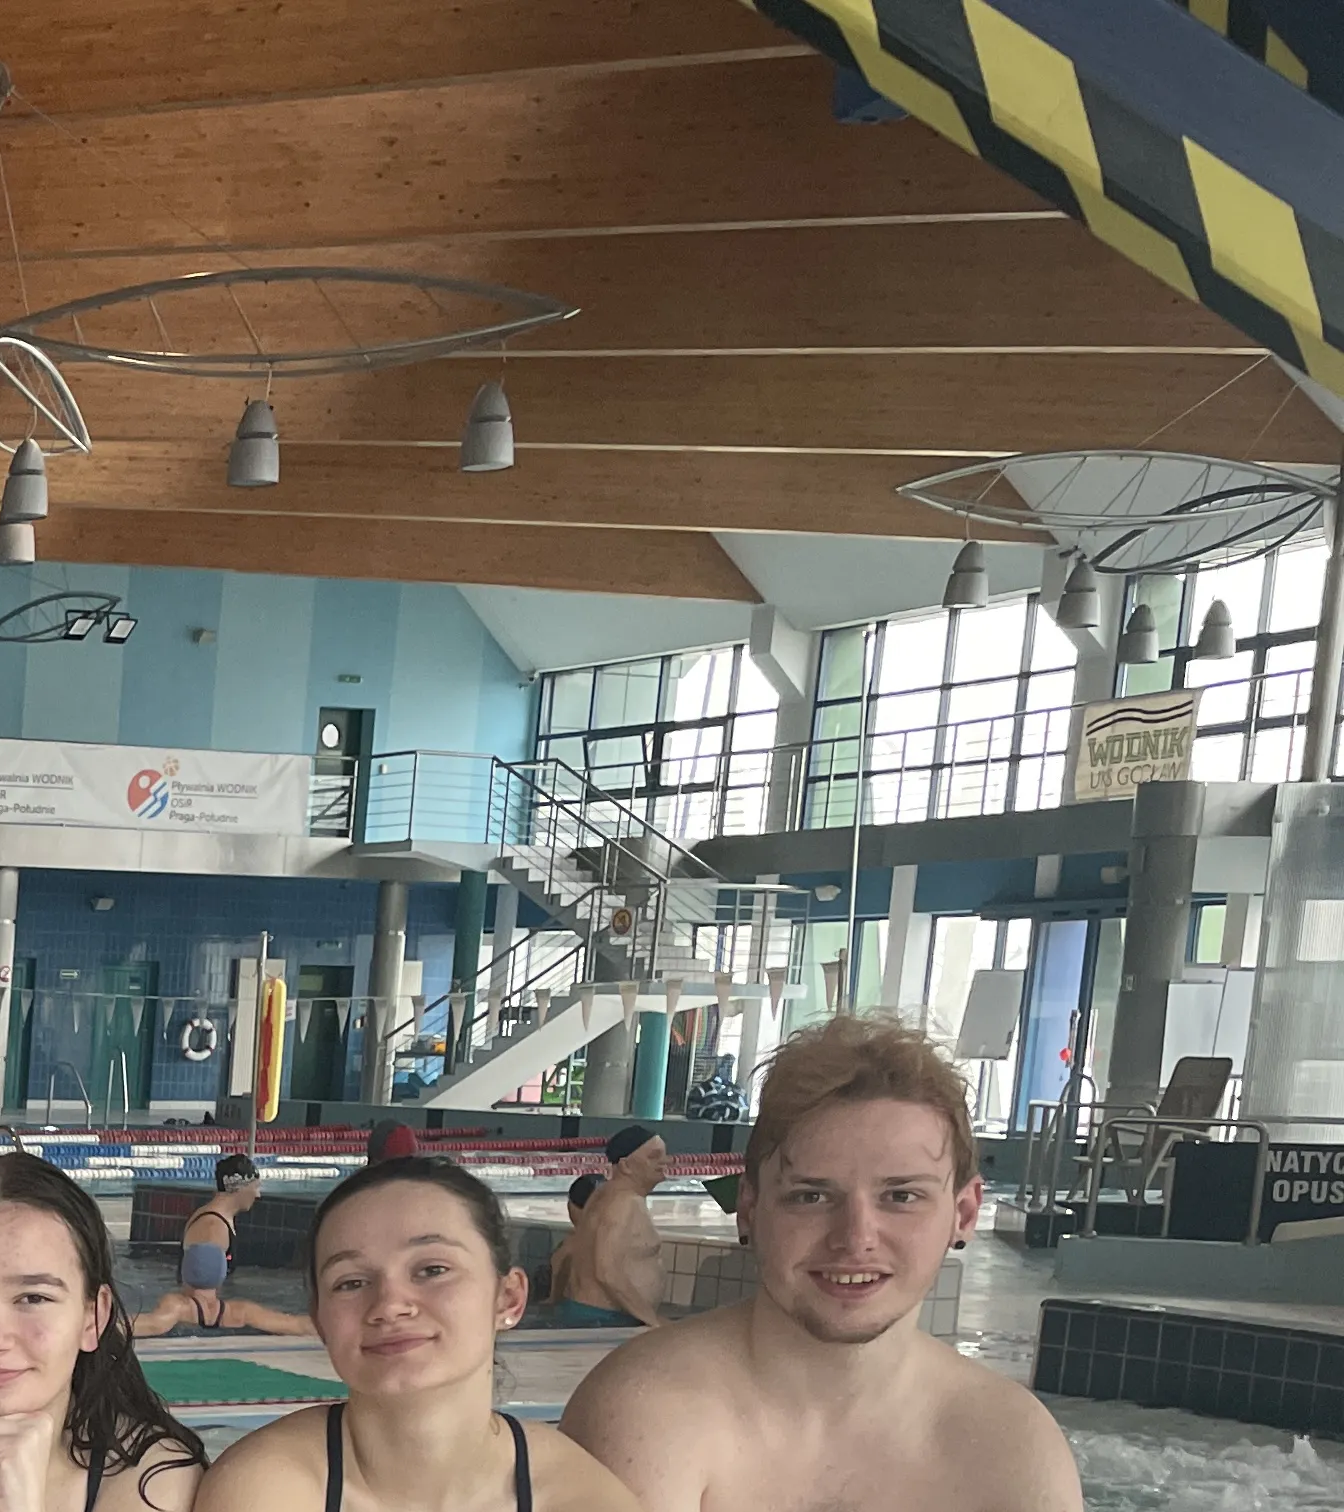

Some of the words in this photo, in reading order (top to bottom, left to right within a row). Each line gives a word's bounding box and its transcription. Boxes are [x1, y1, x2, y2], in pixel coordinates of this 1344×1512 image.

[1088, 726, 1192, 767] WODNIK
[32, 775, 74, 785] WODNIK
[217, 784, 257, 794] WODNIK
[1272, 1179, 1344, 1204] OPUS
